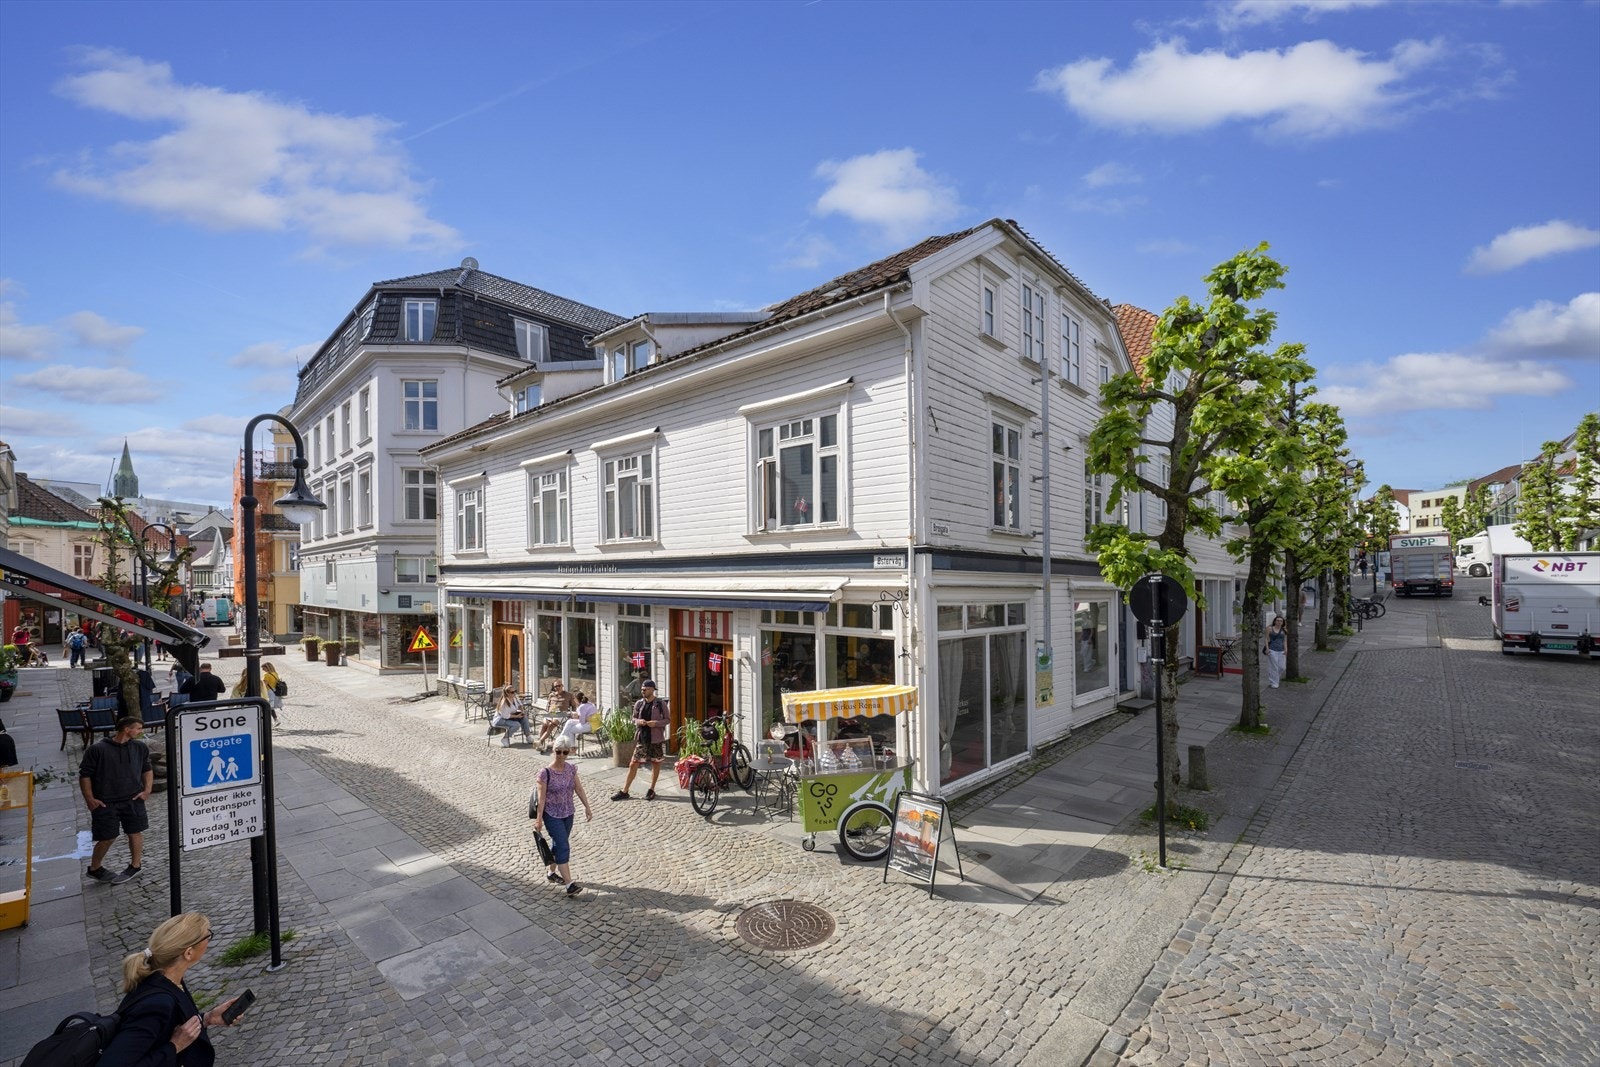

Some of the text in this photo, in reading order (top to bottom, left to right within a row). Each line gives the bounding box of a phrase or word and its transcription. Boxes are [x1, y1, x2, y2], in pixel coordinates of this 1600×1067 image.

[1400, 538, 1436, 547] SVIPP
[877, 556, 902, 566] Østervåg
[1551, 562, 1588, 572] NBT
[833, 703, 856, 711] Sirkus
[195, 715, 247, 731] Sone
[200, 736, 242, 749] Gågate
[193, 789, 252, 807] Gjelder ikke
[189, 798, 257, 816] varetransport
[190, 822, 230, 835] Torsdag
[233, 818, 244, 827] 18
[250, 816, 257, 824] 11
[190, 832, 226, 845] Lørdag
[230, 829, 240, 837] 14
[246, 825, 257, 833] 10
